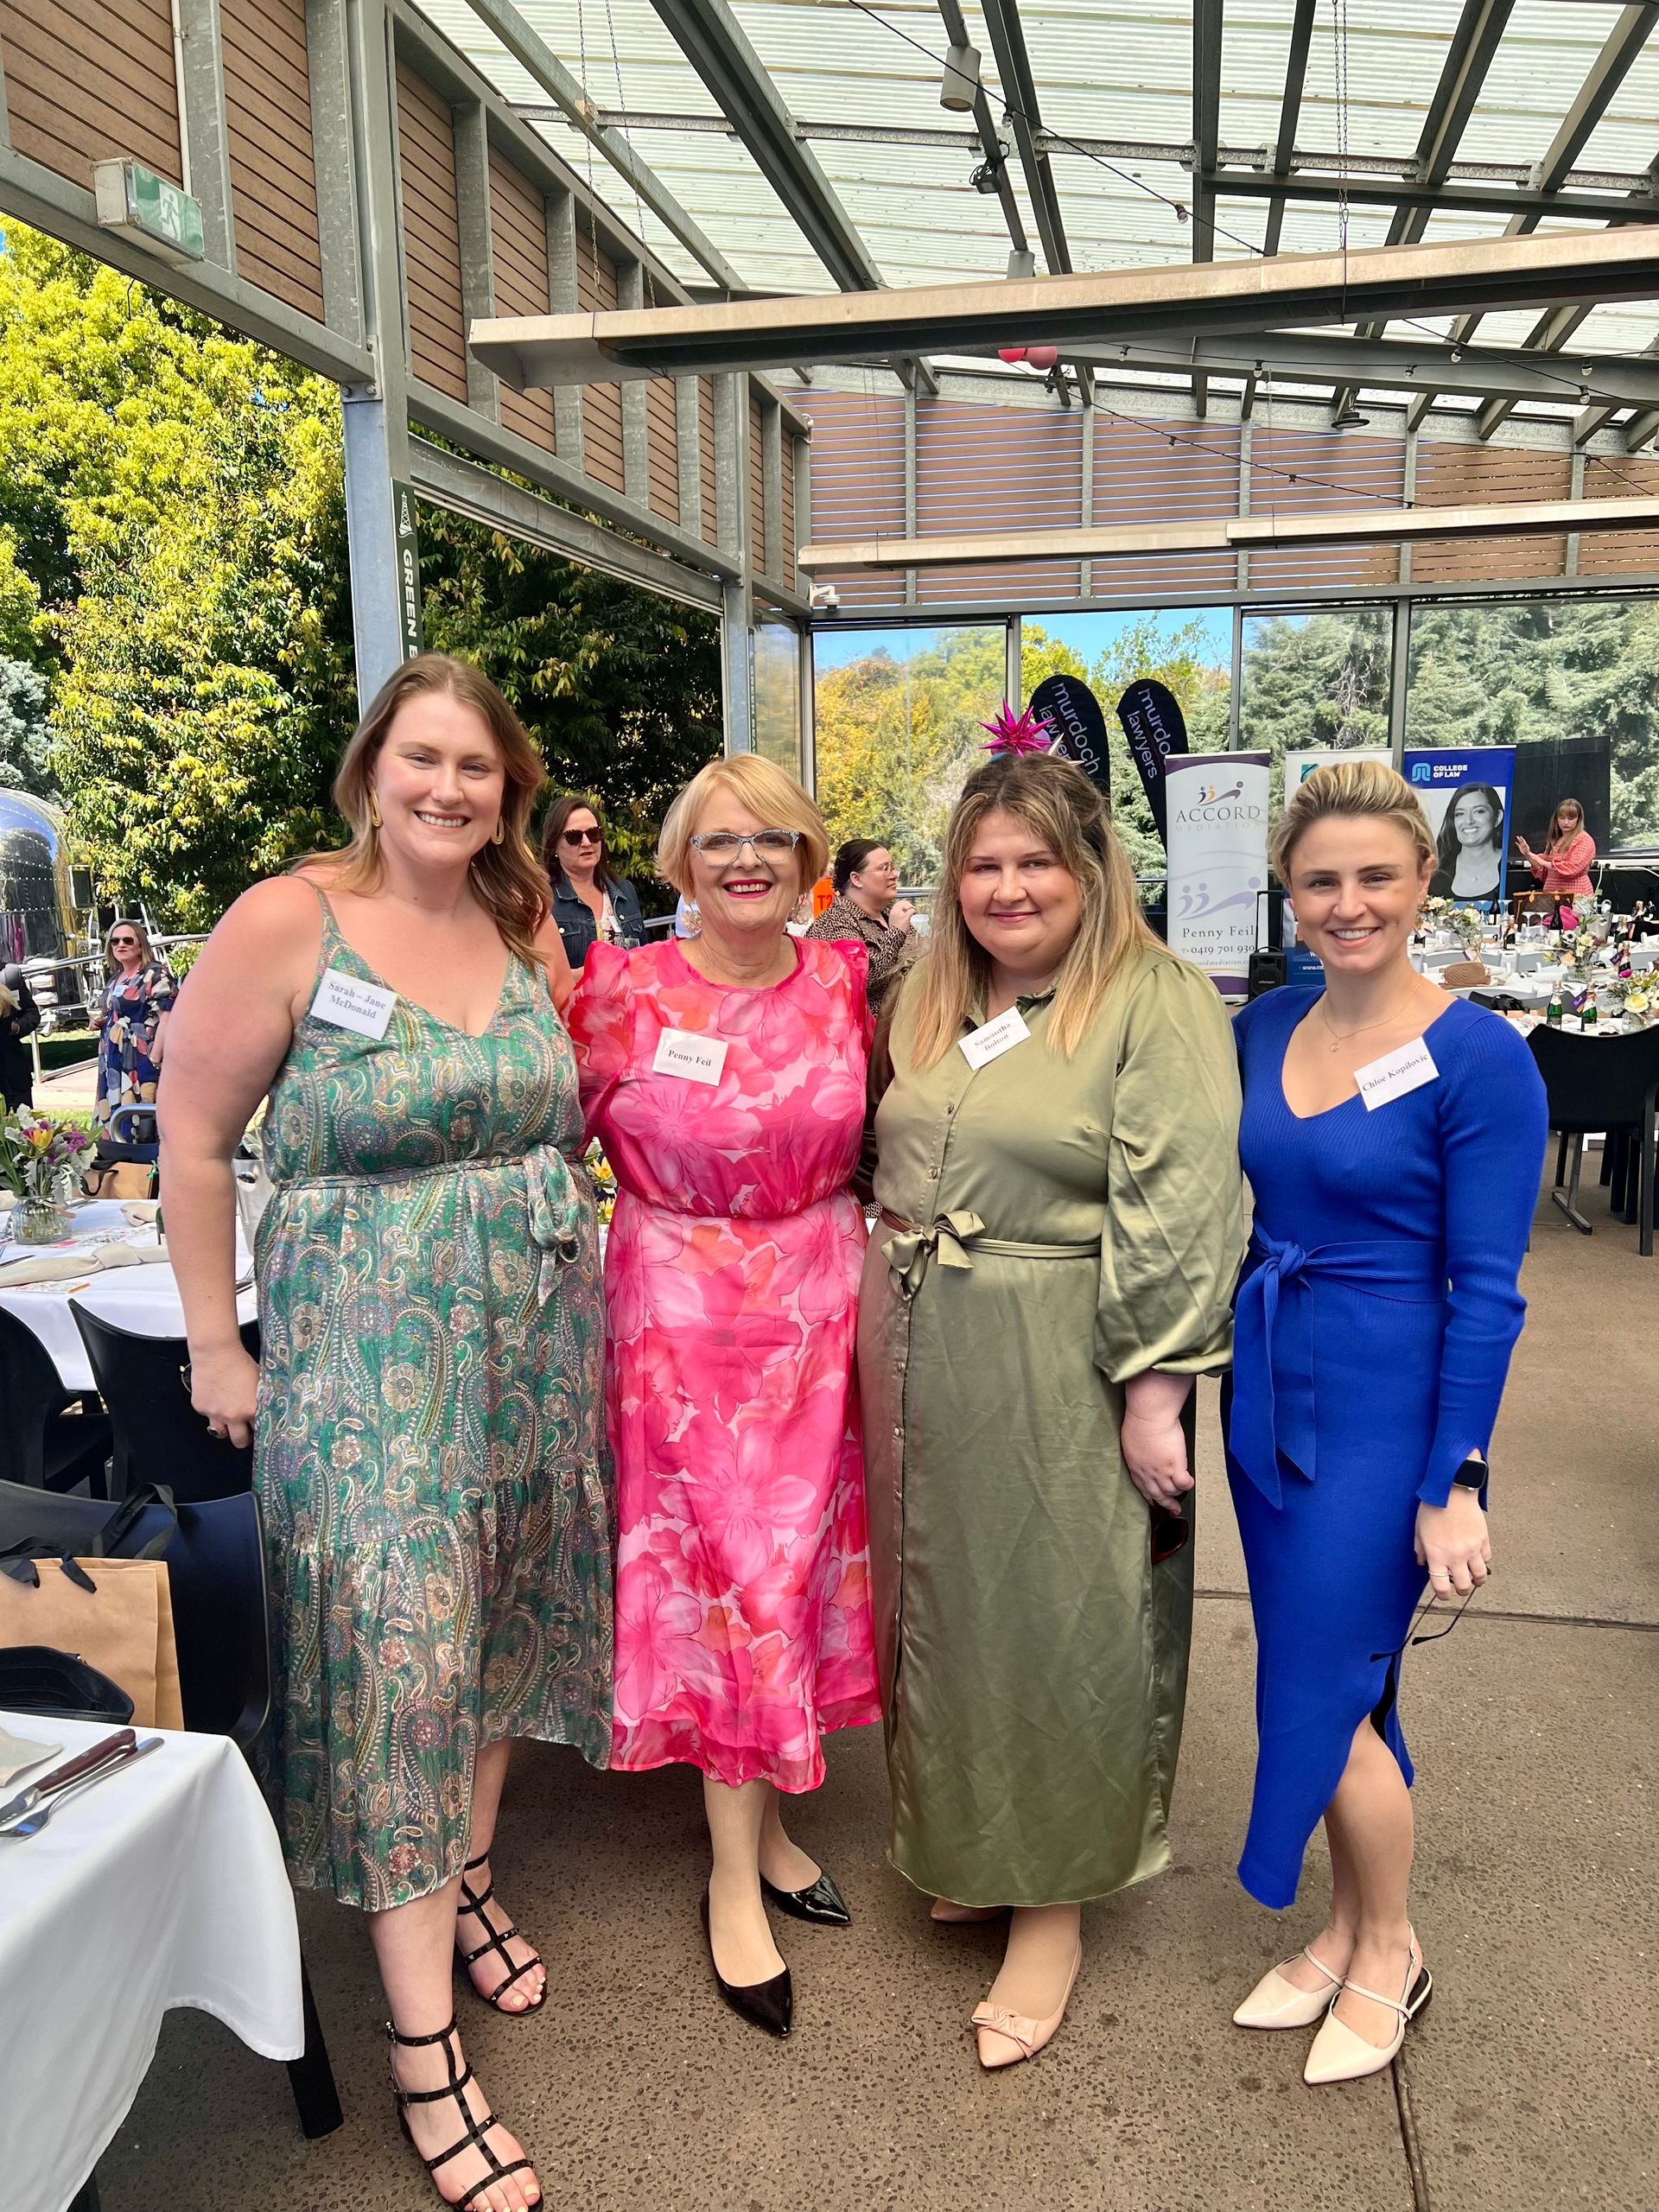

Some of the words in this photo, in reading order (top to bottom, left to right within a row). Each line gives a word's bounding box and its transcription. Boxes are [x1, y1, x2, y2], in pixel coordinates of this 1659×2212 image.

[403, 549, 416, 638] GREEN
[1039, 704, 1071, 760] lawer
[1051, 683, 1101, 775] murdoch
[1138, 688, 1171, 755] murdo
[1127, 710, 1158, 779] lawyers
[1175, 821, 1261, 832] MEDIATION
[1176, 805, 1261, 823] ACCORD
[1183, 927, 1224, 940] Penny
[1230, 925, 1254, 936] Feil
[1217, 945, 1233, 954] 701
[1237, 945, 1255, 954] 930
[328, 981, 355, 999] Sarah
[364, 995, 386, 1010] Jane
[330, 995, 378, 1019] McDonald
[974, 1022, 1011, 1047] Samantha
[983, 1033, 1009, 1052] Bolton
[668, 1050, 693, 1064] Penny
[696, 1056, 712, 1067] Feil
[1362, 1076, 1387, 1091] Chloe
[1388, 1054, 1428, 1078] Kopilovic
